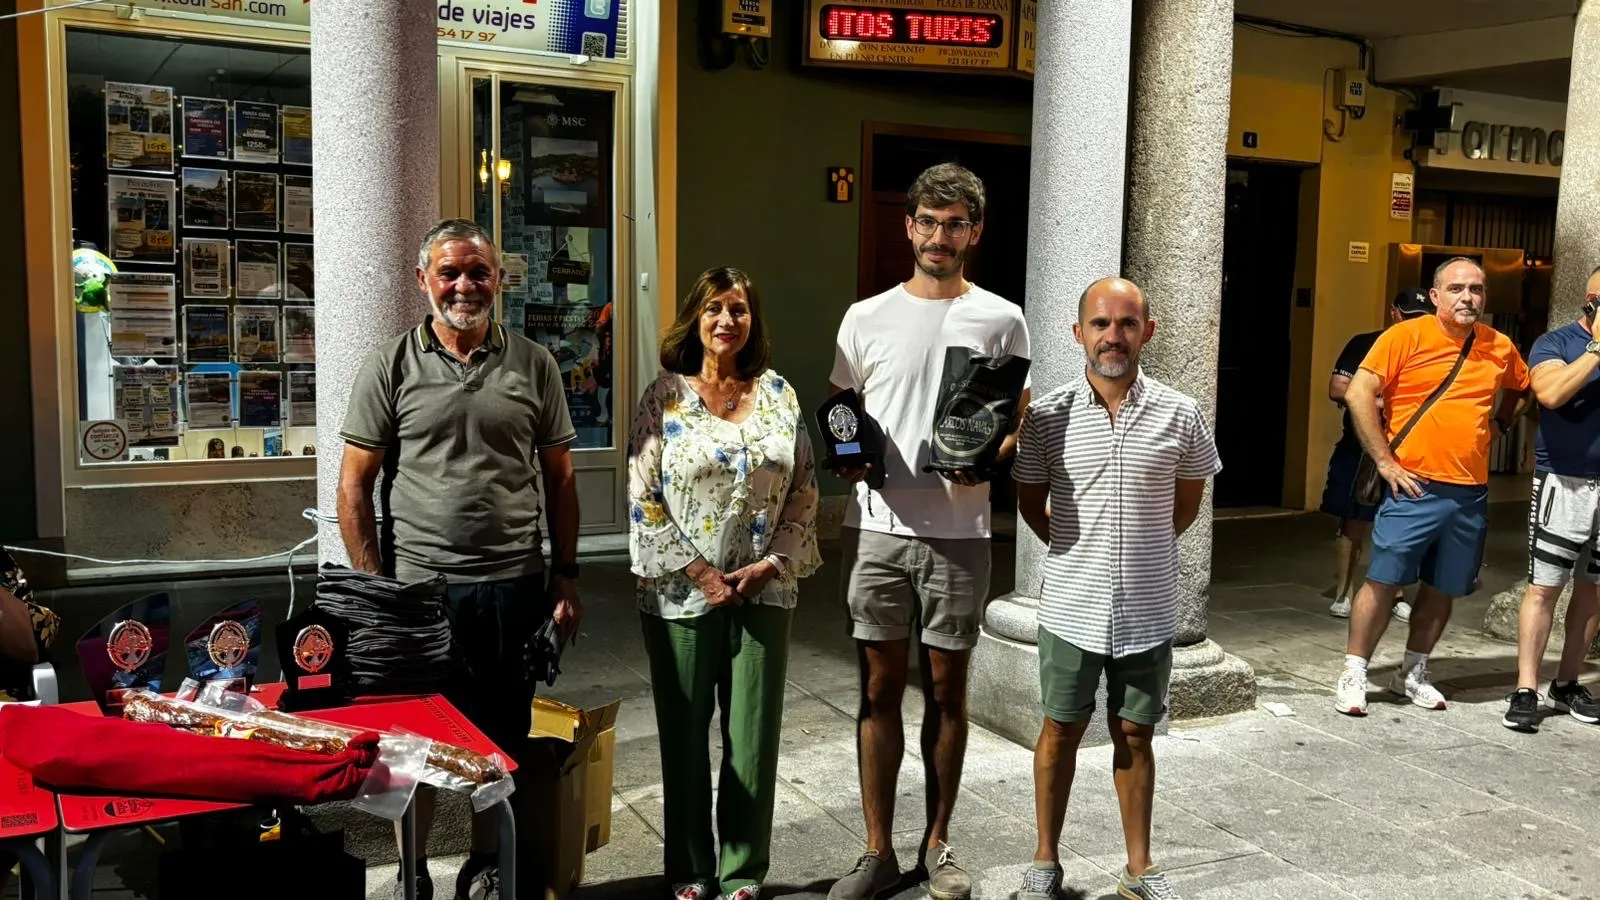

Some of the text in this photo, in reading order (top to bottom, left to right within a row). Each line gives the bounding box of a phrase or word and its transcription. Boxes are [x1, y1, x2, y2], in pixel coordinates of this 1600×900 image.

[438, 4, 535, 32] de viajes
[460, 30, 474, 40] 17
[477, 33, 497, 42] 97
[562, 116, 587, 127] MSC
[552, 267, 587, 277] CERRADO
[967, 418, 992, 436] NAVAS
